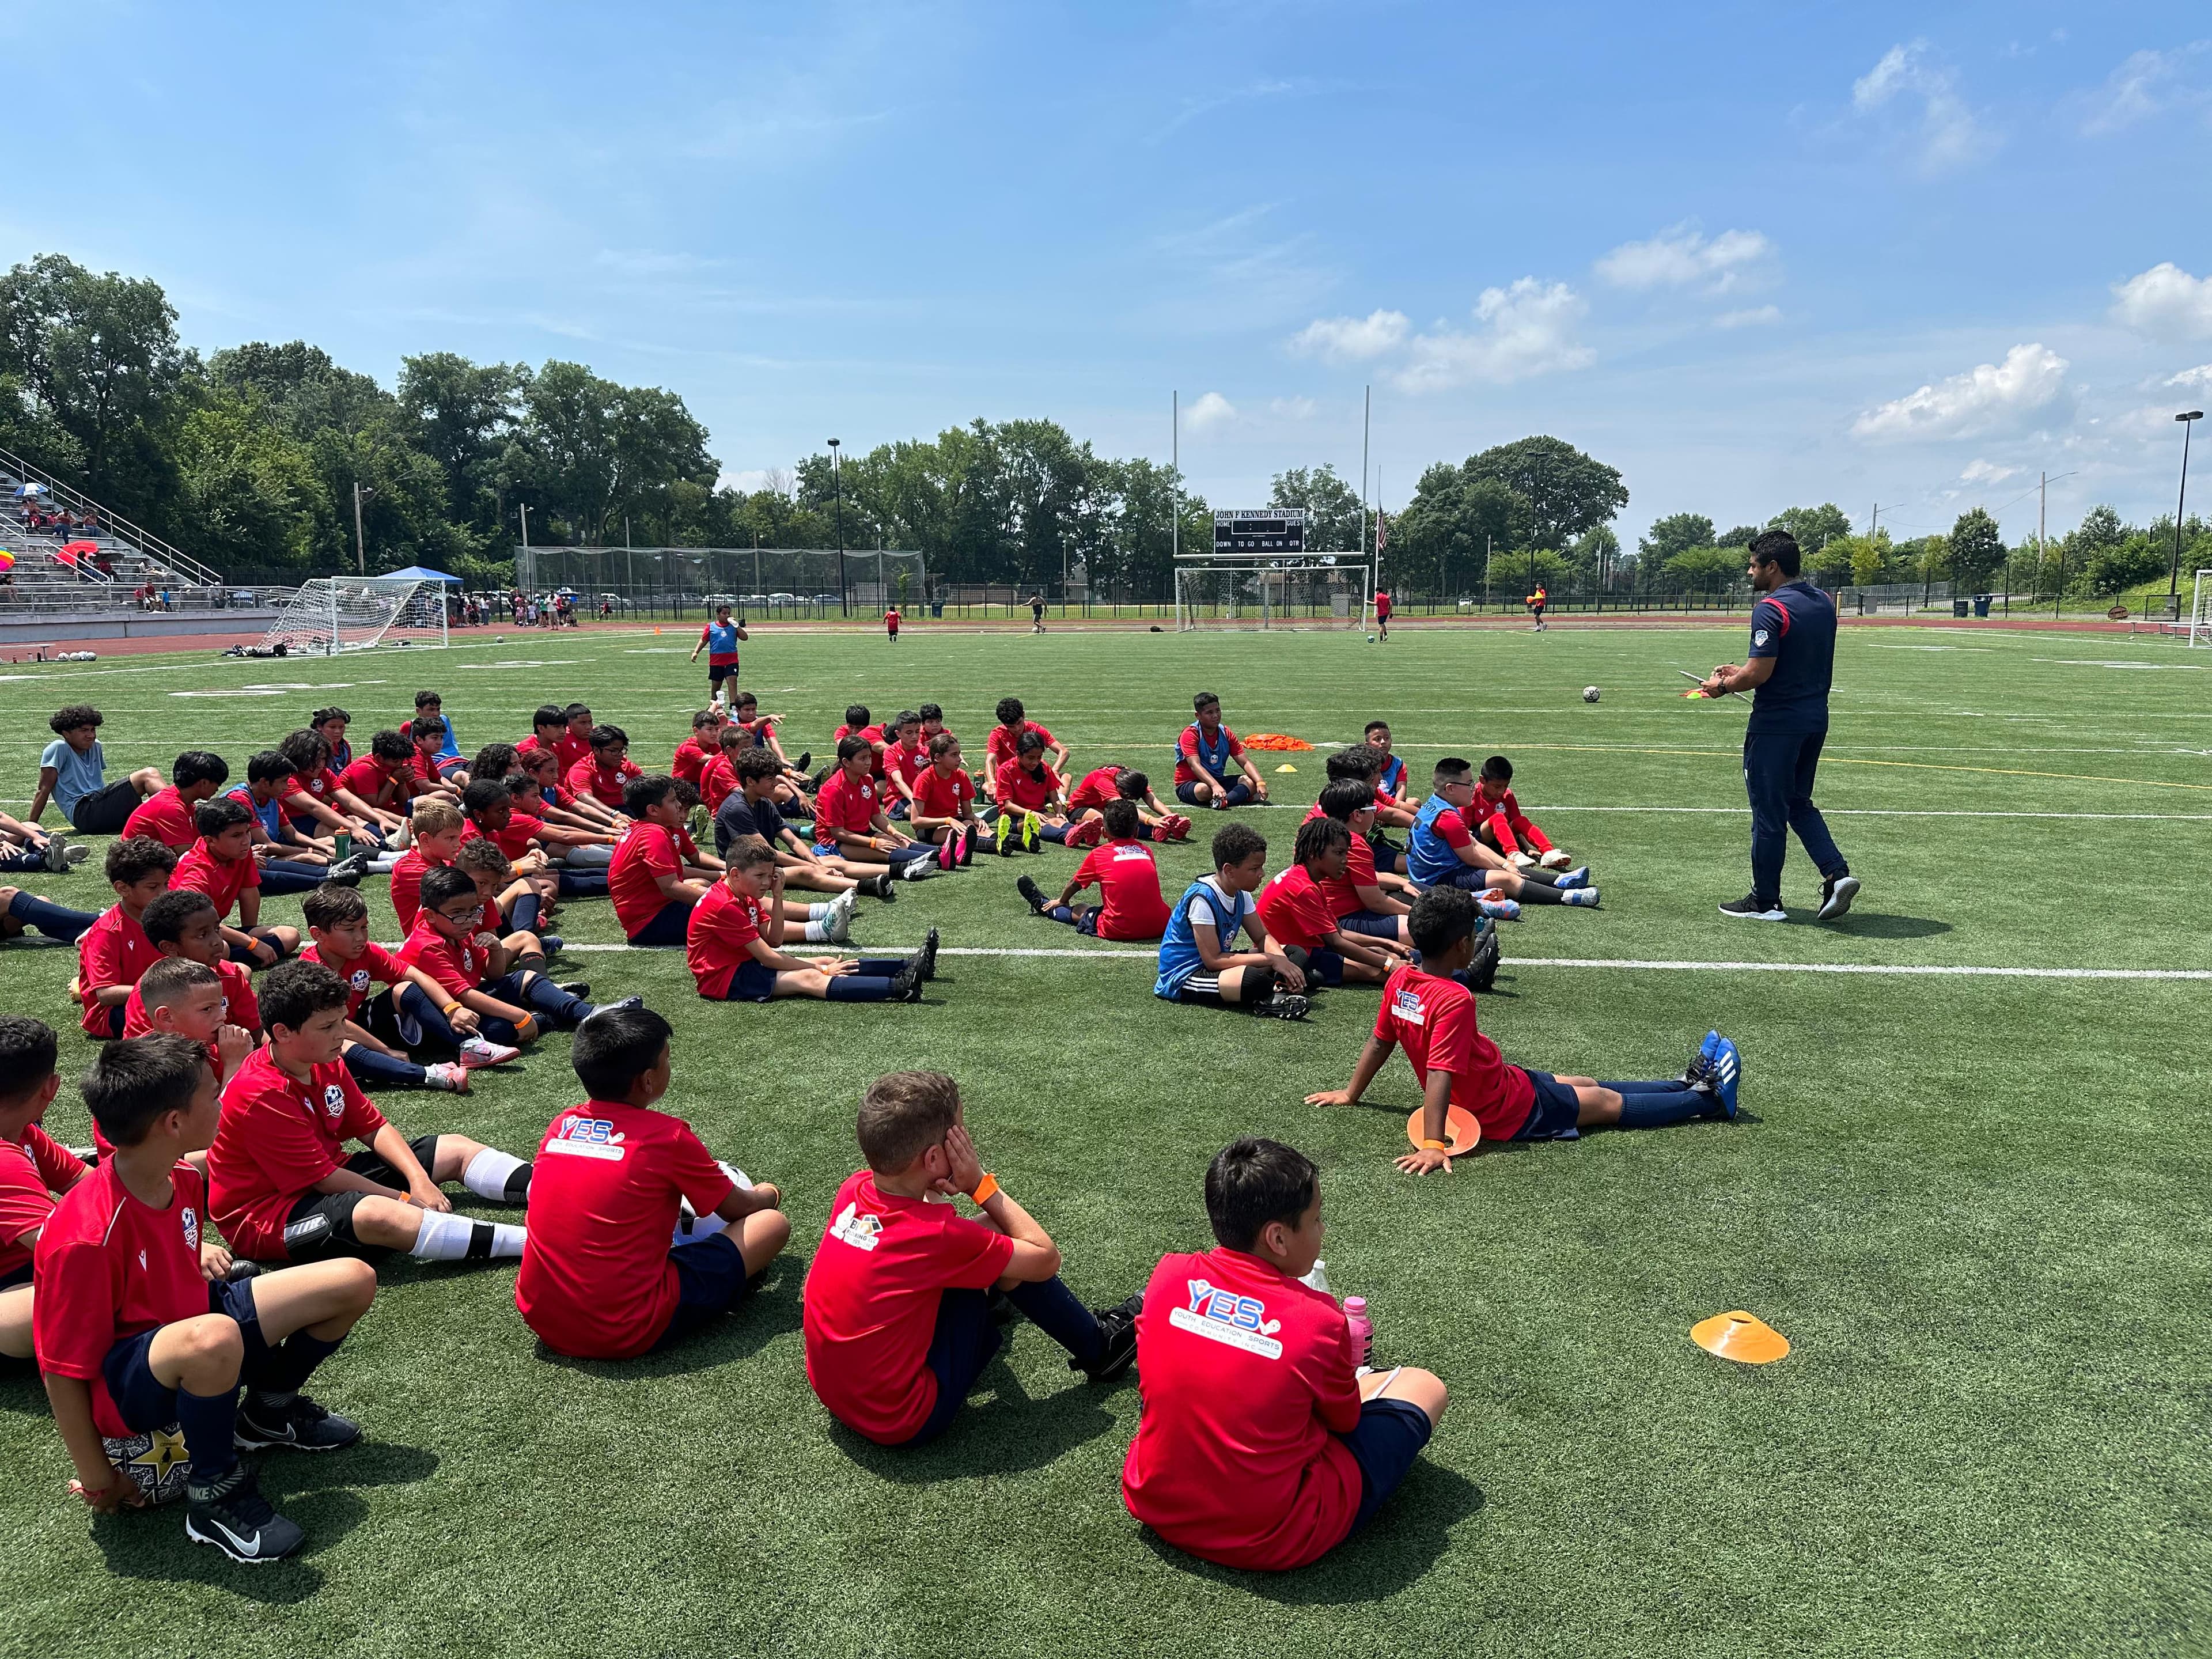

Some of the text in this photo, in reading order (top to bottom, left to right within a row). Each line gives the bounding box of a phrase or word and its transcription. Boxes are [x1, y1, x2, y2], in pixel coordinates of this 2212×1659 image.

[1216, 510, 1233, 518] JOHN
[1274, 510, 1303, 518] STADIUM
[1396, 989, 1420, 1011] YES
[558, 1118, 613, 1143] YES
[1188, 1280, 1264, 1330] YES
[1174, 1310, 1280, 1350] YOUTH EDUCATION SPORTS
[1189, 1324, 1237, 1343] COMMUNITY
